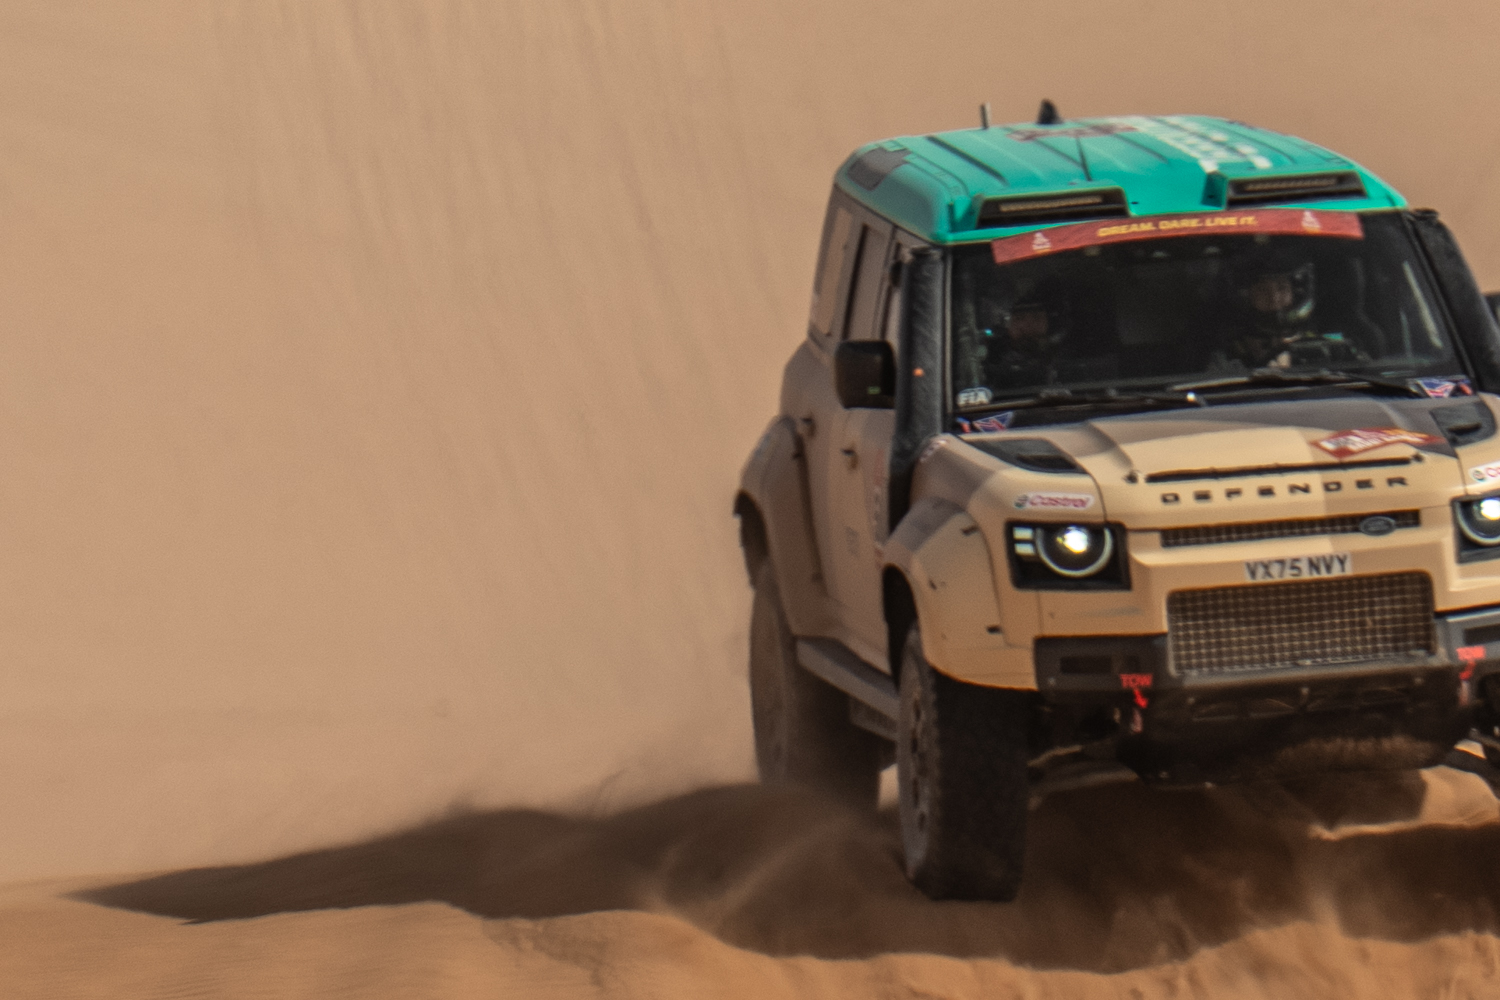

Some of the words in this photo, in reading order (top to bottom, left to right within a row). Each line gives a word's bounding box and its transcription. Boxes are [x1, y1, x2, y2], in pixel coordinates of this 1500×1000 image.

[1205, 216, 1237, 227] LIVE
[957, 390, 991, 406] FIA
[1161, 476, 1408, 503] DEFENDER
[1029, 494, 1090, 508] Castrol
[1245, 557, 1303, 580] VX75
[1308, 554, 1348, 576] NVY
[1455, 645, 1487, 661] TOW
[1120, 673, 1153, 689] TOW
